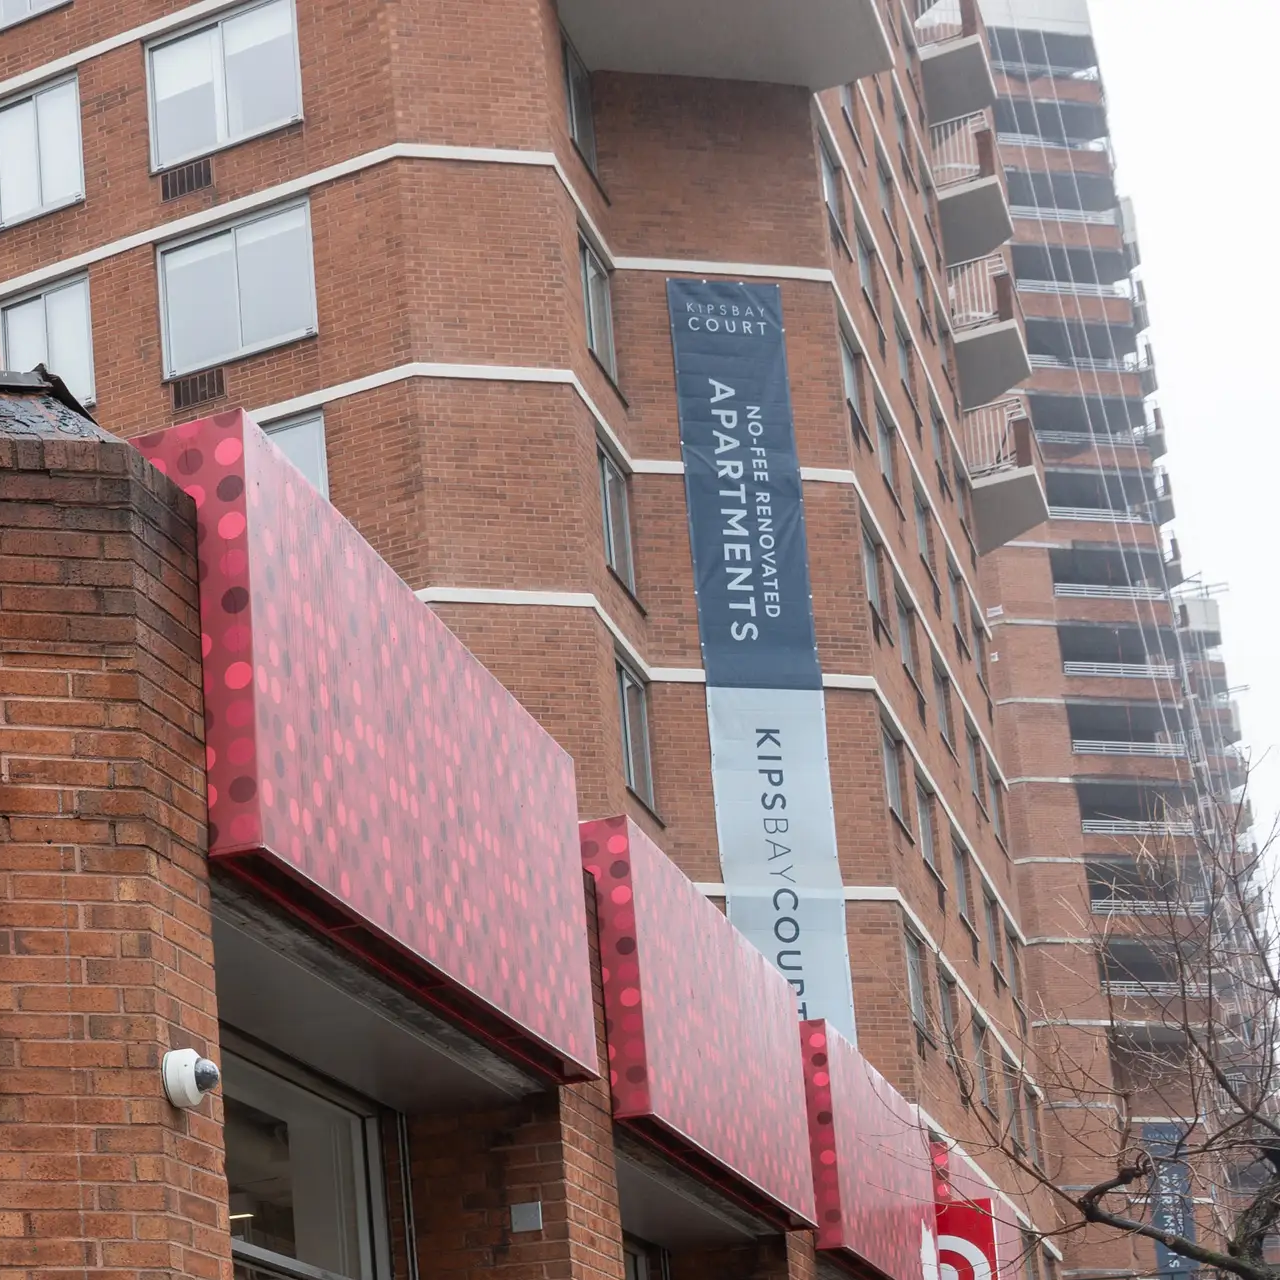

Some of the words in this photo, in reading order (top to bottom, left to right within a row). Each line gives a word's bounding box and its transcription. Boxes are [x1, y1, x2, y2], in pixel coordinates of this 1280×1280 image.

[686, 302, 766, 318] KIPSBAY
[687, 316, 768, 336] COURT
[745, 405, 769, 482] NO-FEE
[708, 377, 759, 641] APARTMENTS
[755, 491, 781, 618] RENOVATED
